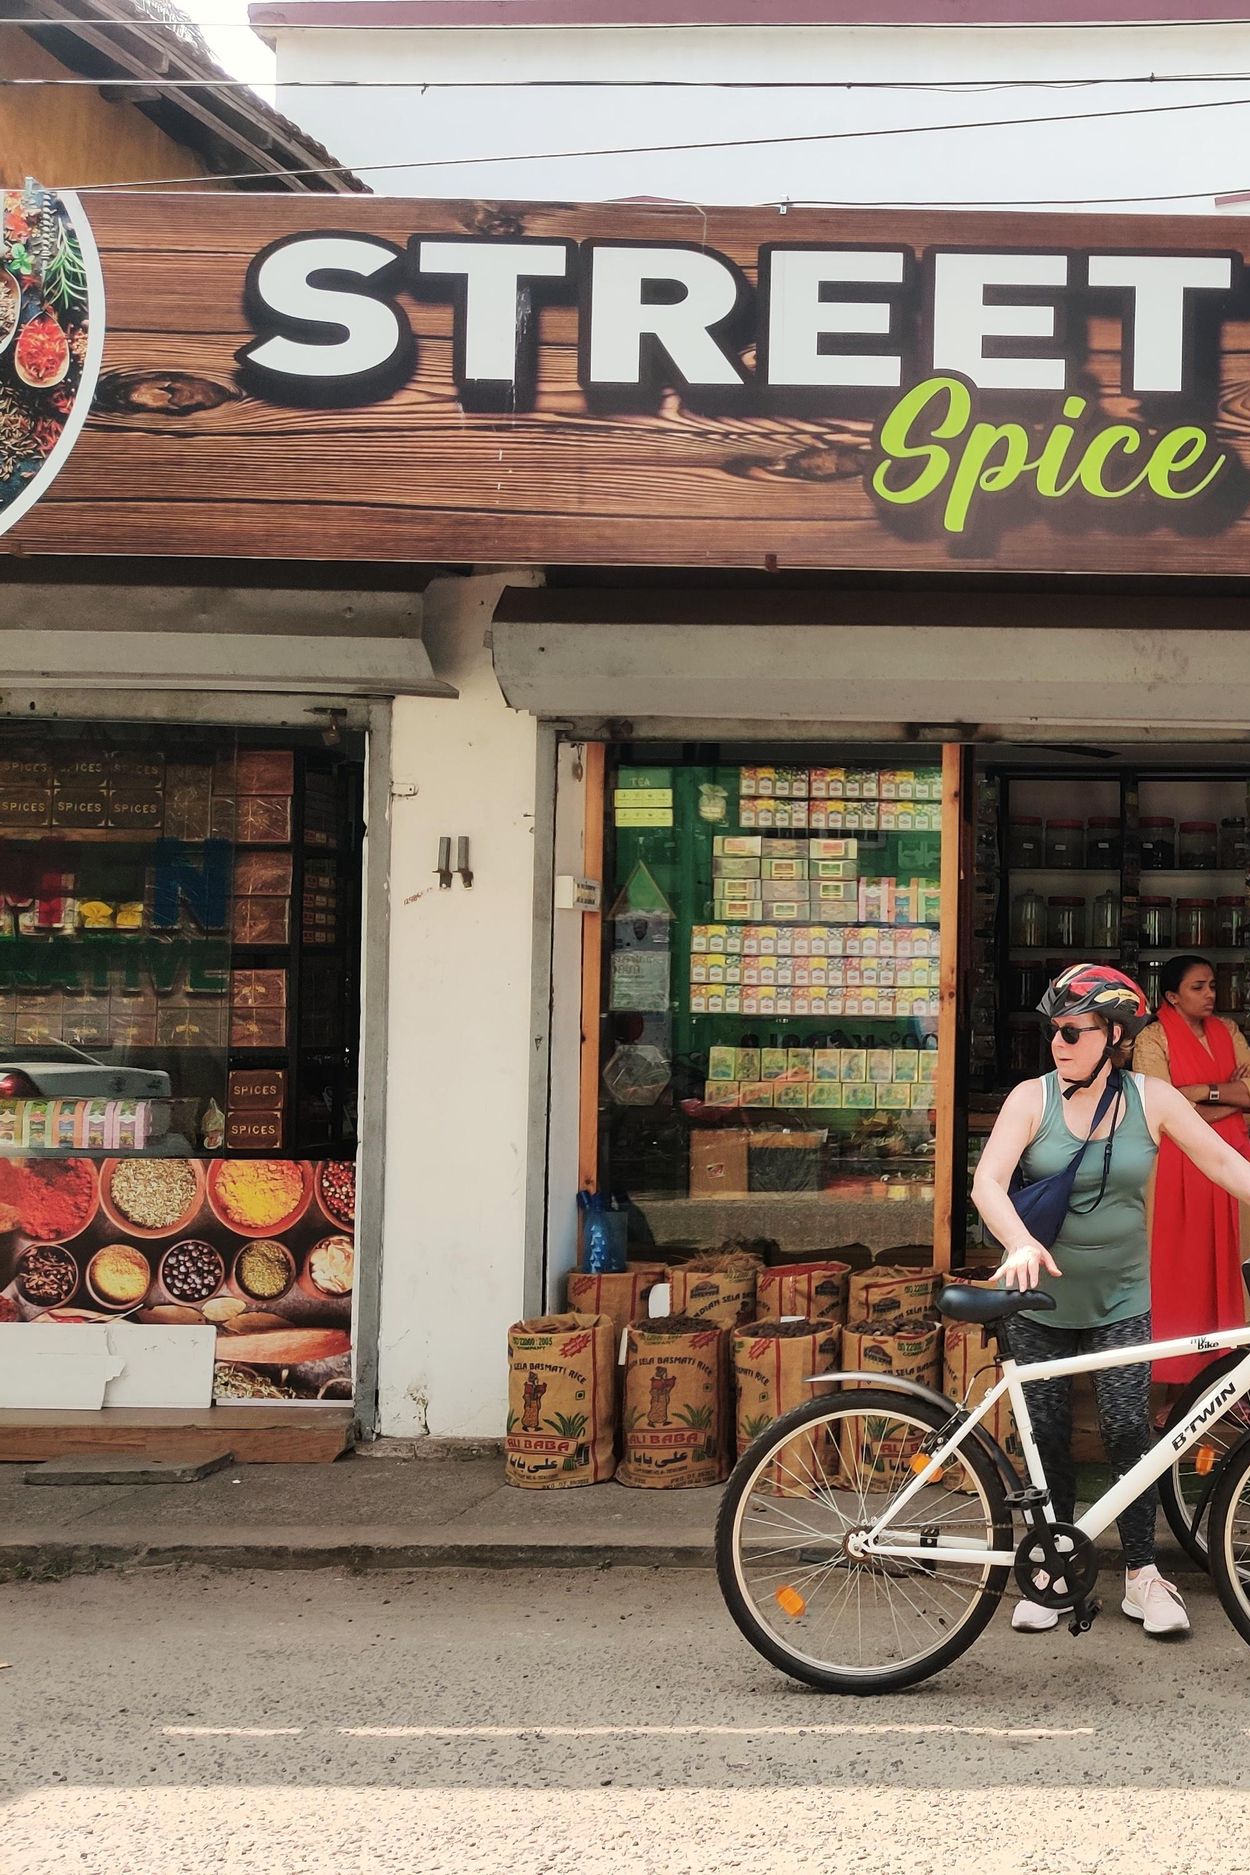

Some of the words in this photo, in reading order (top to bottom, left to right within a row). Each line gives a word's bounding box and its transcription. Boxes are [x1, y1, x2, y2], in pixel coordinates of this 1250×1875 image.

[245, 237, 1231, 392] STREET
[873, 374, 1228, 533] Spice
[1, 801, 46, 812] SPICES
[57, 801, 102, 813] SPICES
[114, 803, 157, 814] SPICES
[233, 1085, 277, 1096] SPICES
[231, 1125, 276, 1135] SPICES
[722, 1292, 740, 1303] SELA
[1197, 1341, 1219, 1350] Bike
[657, 1356, 696, 1367] BASMATI
[696, 1358, 712, 1377] RICE
[896, 1367, 915, 1377] SELA
[529, 1363, 566, 1374] BASMATI
[568, 1370, 587, 1385] RICE
[629, 1434, 646, 1444] ALI
[650, 1432, 698, 1444] BABA
[507, 1438, 520, 1448] ALI
[524, 1440, 569, 1452] BABA
